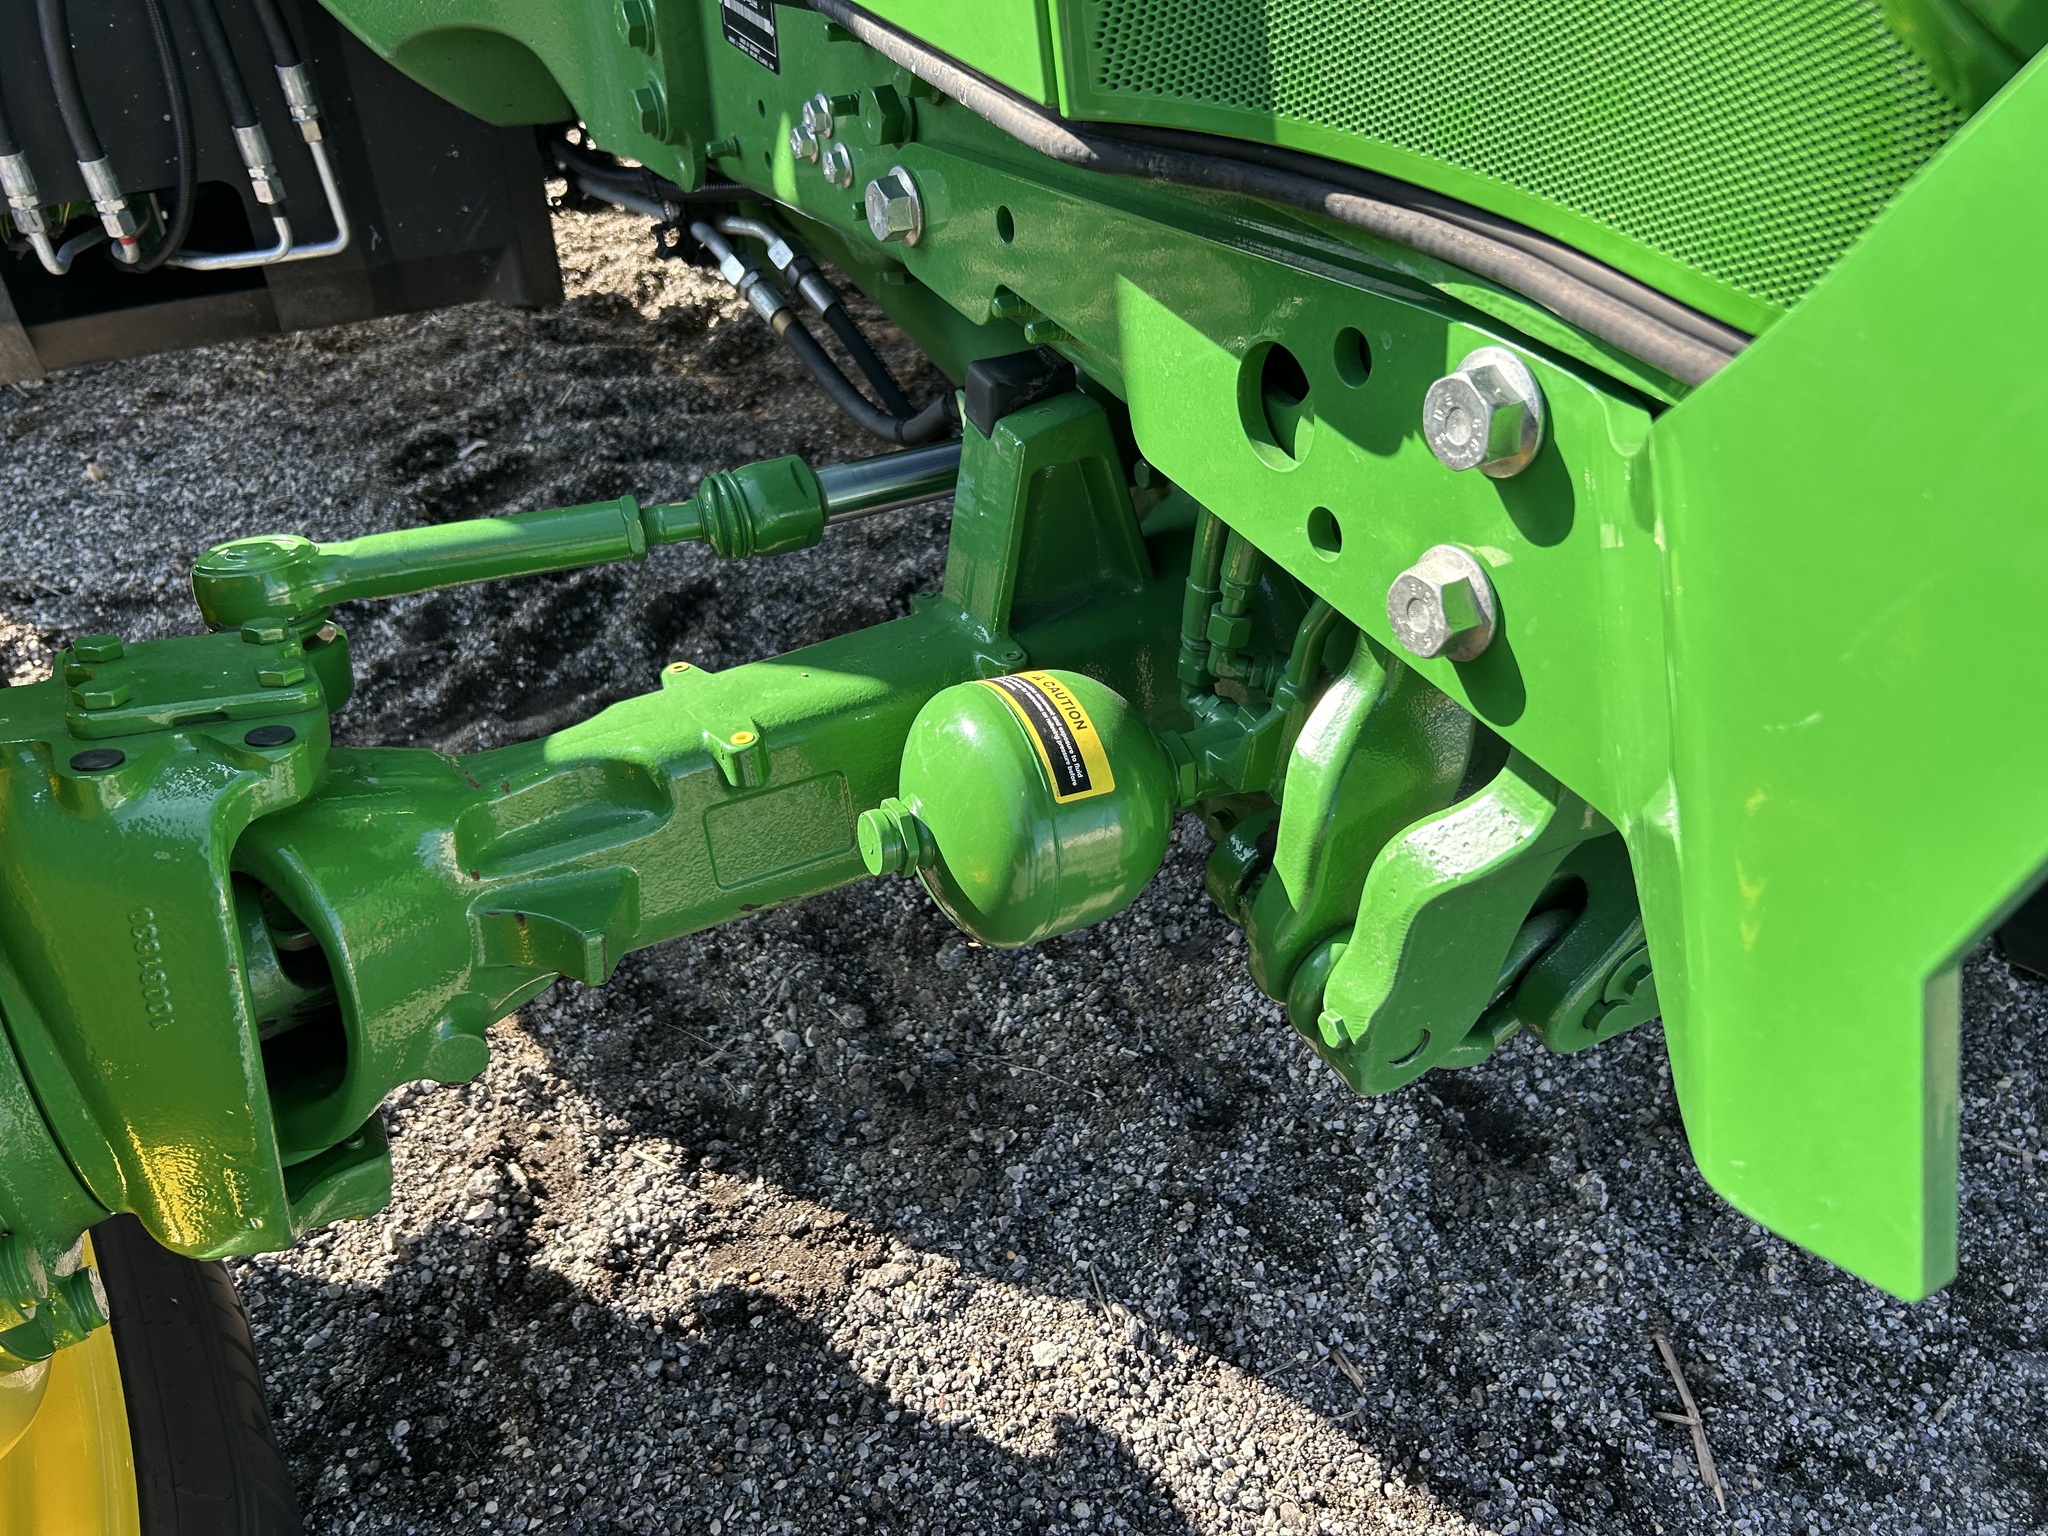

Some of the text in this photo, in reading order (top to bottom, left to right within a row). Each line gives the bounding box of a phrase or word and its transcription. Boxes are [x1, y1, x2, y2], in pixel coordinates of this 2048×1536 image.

[1043, 681, 1088, 731] CAUTION
[1052, 715, 1063, 727] and
[1058, 726, 1074, 755] exposure
[1046, 718, 1061, 740] relieving
[1056, 740, 1071, 766] pressure
[1067, 765, 1078, 786] before
[1071, 754, 1078, 763] to
[1074, 762, 1084, 778] fluid
